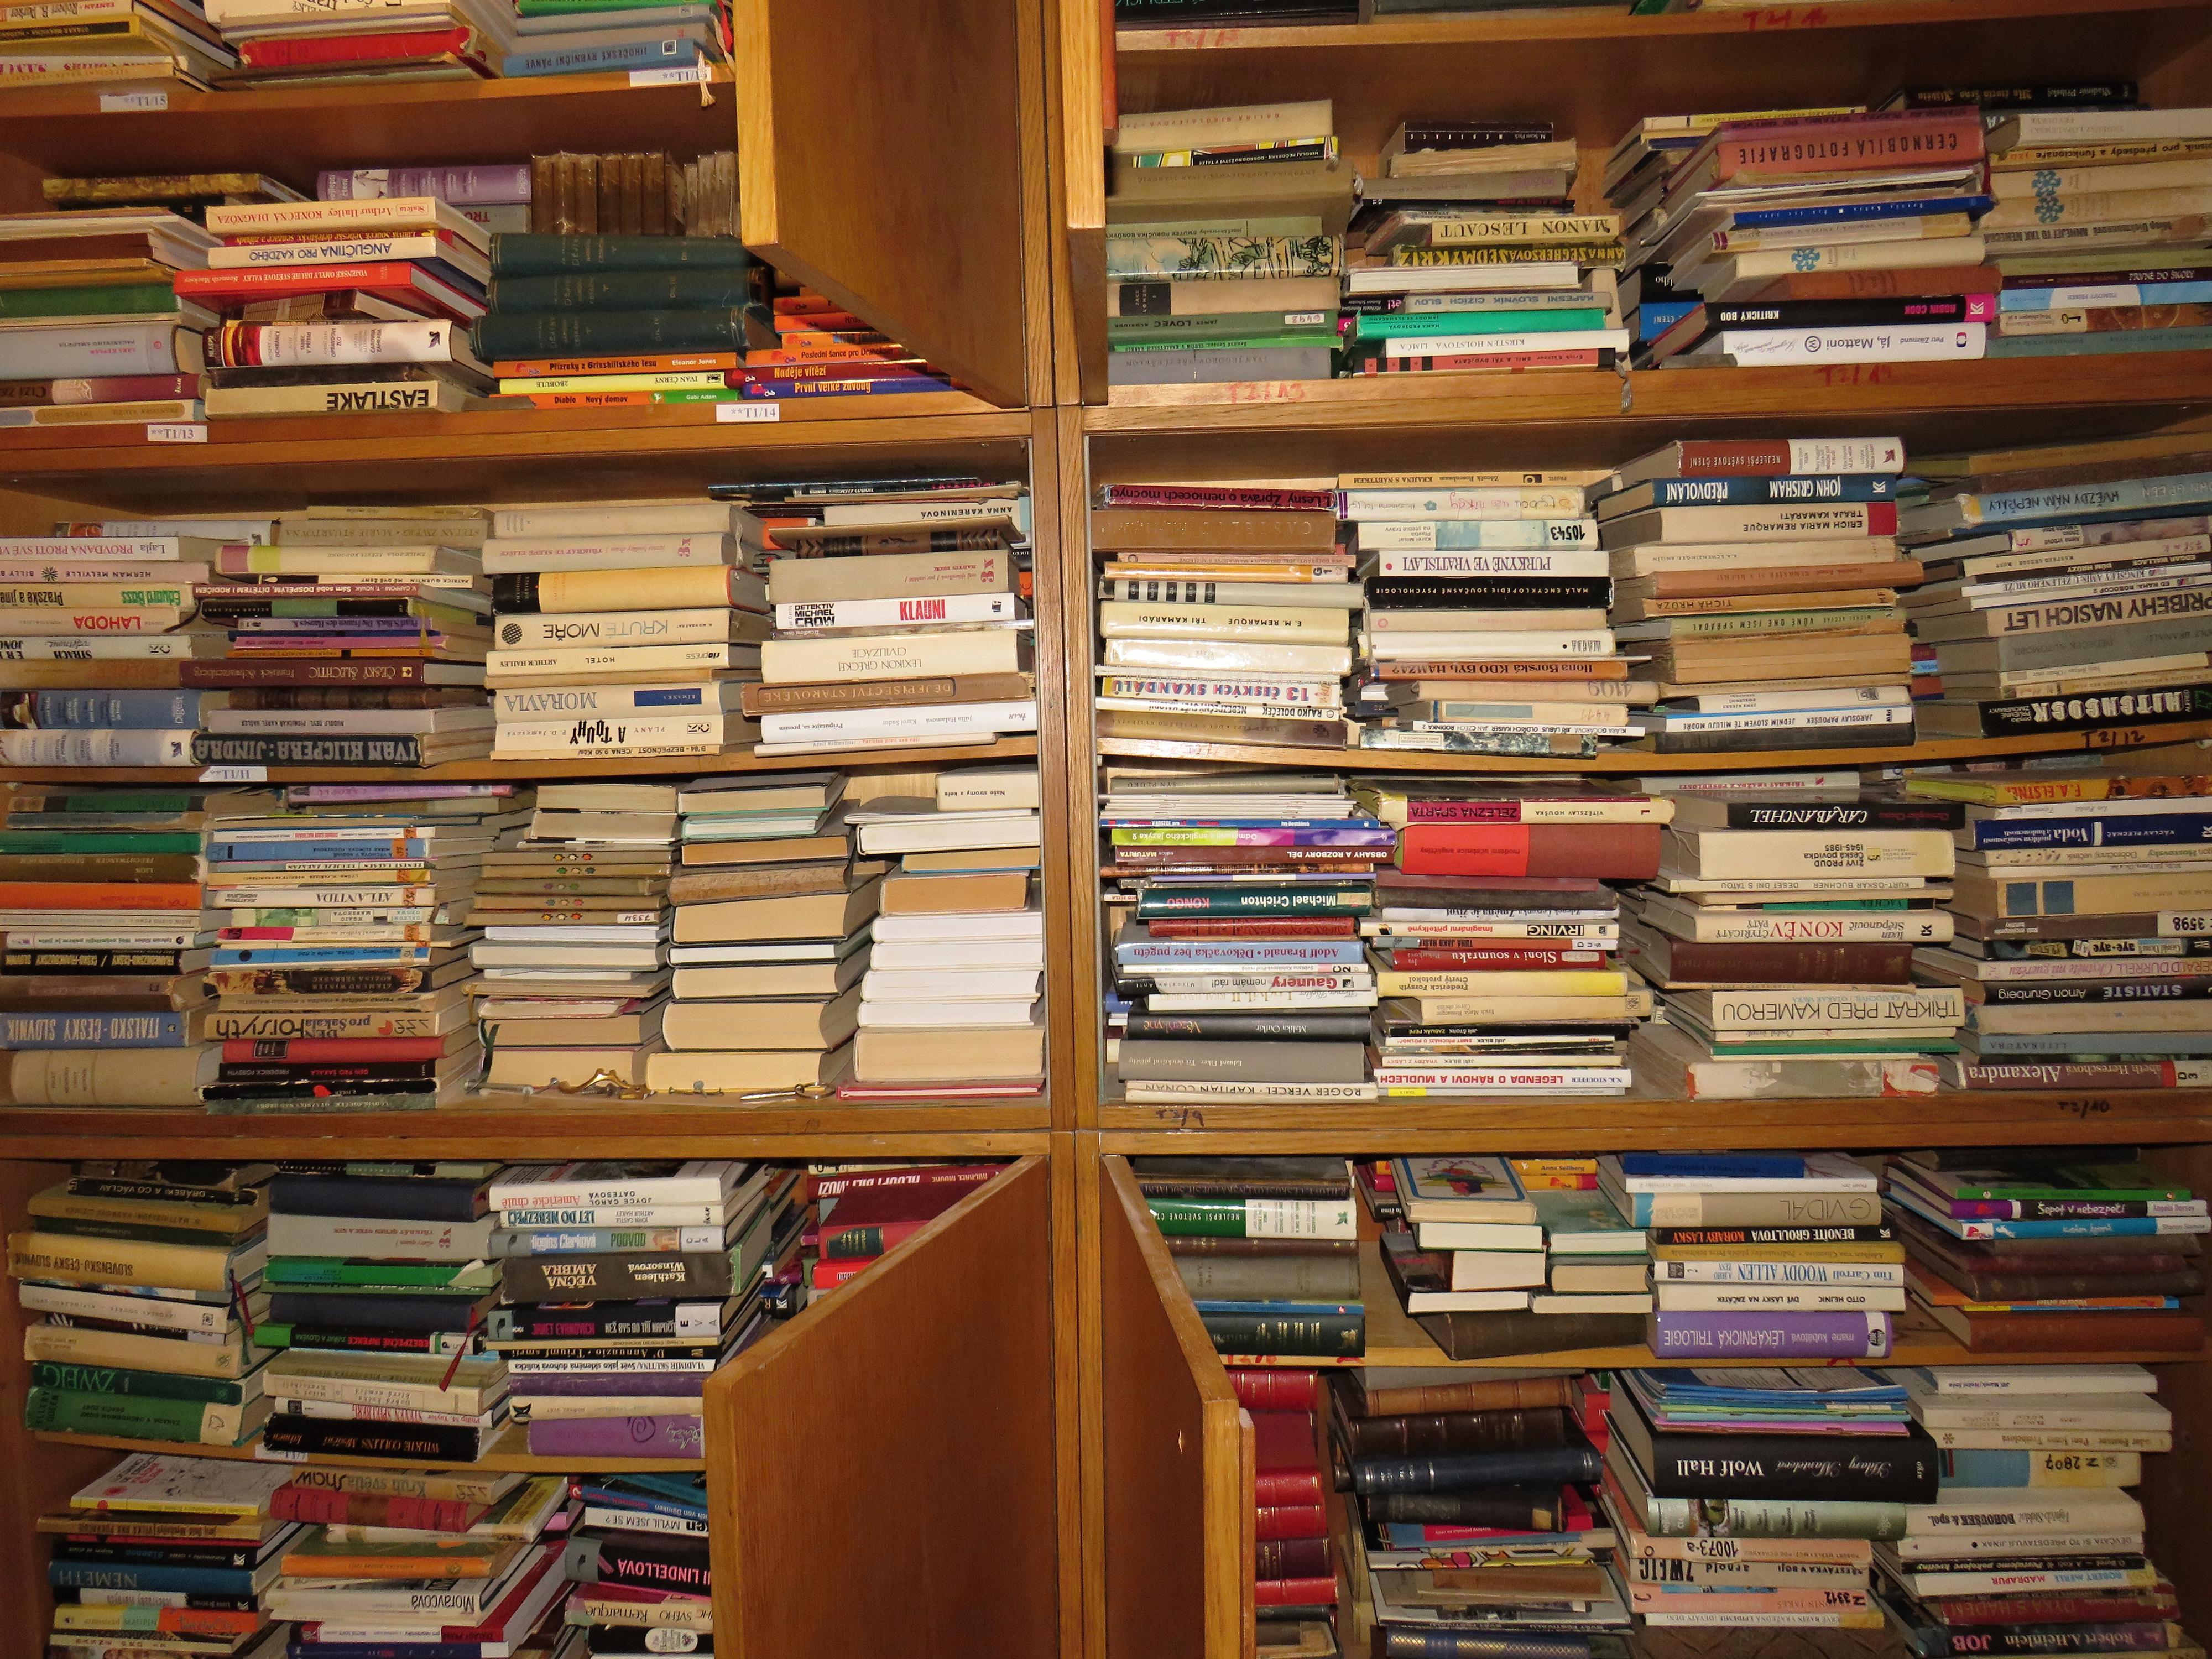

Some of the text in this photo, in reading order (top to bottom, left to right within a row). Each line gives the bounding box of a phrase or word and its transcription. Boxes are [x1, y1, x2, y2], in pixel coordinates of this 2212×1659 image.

[1738, 133, 1958, 165] ČERNOBÍLÁ FOTOGRAFIE
[2111, 147, 2157, 157] předsedy
[2162, 143, 2180, 154] pro
[217, 207, 393, 224] Arthur Hailey KONEČNÁ DIAGNÓZA
[1440, 221, 1527, 238] LESCAUT
[249, 243, 392, 263] ANGLIČTINA PRO KAŽDÉHO
[1415, 294, 1594, 306] KAPESNÍ SLOVNÍK CIZÍCH SLOV
[1154, 319, 1191, 328] LOVEC
[1720, 310, 1779, 324] KRITICKÝ BOD
[1436, 337, 1525, 351] KIRSTEN HOLSTOVÁ
[1827, 337, 1873, 351] Mattoni
[1877, 335, 1890, 349] Já,
[1900, 337, 1928, 346] Zikmund
[654, 375, 679, 385] ČERNÝ
[326, 389, 430, 411] EASTLAKE
[1354, 477, 1393, 486] NÁBYTKEM
[1476, 476, 1499, 484] Zdeněk
[1666, 476, 1841, 504] JOHN GRISHAM PŘEDVOLÁNÍ
[921, 508, 983, 520] KARENINOVÁ
[1743, 520, 1863, 533] ERICH MARIA REMARQUE
[12, 543, 165, 556] Lajla PROVDANÁ PROTI SVÉ
[1402, 556, 1551, 573] PURKYNĚ VE VRATISLAVI
[73, 615, 141, 630] LAHODA
[542, 619, 669, 641] KRUTÉ MOŘE
[852, 648, 906, 658] CIVILIZÁCIE
[838, 659, 921, 671] LEXIKON GRÉCKEJ
[260, 668, 295, 679] František
[308, 666, 358, 681] ŠLECHTIC
[363, 666, 395, 681] ČESKÝ
[1113, 680, 1309, 702] 13 ČESKÝCH SKANDÁLŮ
[503, 692, 597, 712] MORAVIA
[2031, 691, 2184, 723] HITCHCOCK
[1262, 706, 1322, 718] RAJKO DOLEČEK
[1841, 714, 1872, 722] JAROSLAV
[1683, 722, 1705, 731] MODŘE
[1734, 721, 1741, 729] TĚ
[1744, 719, 1768, 728] SLOVEM
[1771, 718, 1796, 727] JEDNÍM
[1806, 716, 1839, 724] PAPOUŠEK
[779, 723, 801, 732] prosím
[195, 739, 417, 763] IVAN KLICPERA JINDRA
[1750, 806, 1867, 823] CARABANCHEL
[316, 893, 393, 901] ATLANTIDA
[1166, 895, 1337, 909] Michael Crichton KONGO
[1528, 925, 1583, 935] IRVING
[2173, 917, 2205, 931] 3598
[1212, 977, 1337, 989] Gaunery nemám rád!
[1445, 975, 1468, 984] Čtvrtý
[1399, 982, 1427, 991] Forsyth
[1723, 1001, 1959, 1021] TŘIKRÁT PŘED KAMEROU
[1969, 1064, 2128, 1083] Hereschová Alexandra
[542, 1264, 596, 1275] AMBRA
[628, 1262, 685, 1272] Winsorová
[1738, 1264, 1894, 1282] Tim Carroll WOODY ALLEN
[546, 1275, 596, 1289] VĚČNÁ
[635, 1272, 686, 1282] Kathleen
[41, 1365, 115, 1392] ZWEIG
[1677, 1460, 1764, 1477] Wolf Hall
[1991, 1576, 2045, 1585] MADRAPUR
[411, 1594, 474, 1612] Moravcová
[586, 1606, 648, 1621] Remarque
[1952, 1634, 1991, 1651] JOB
